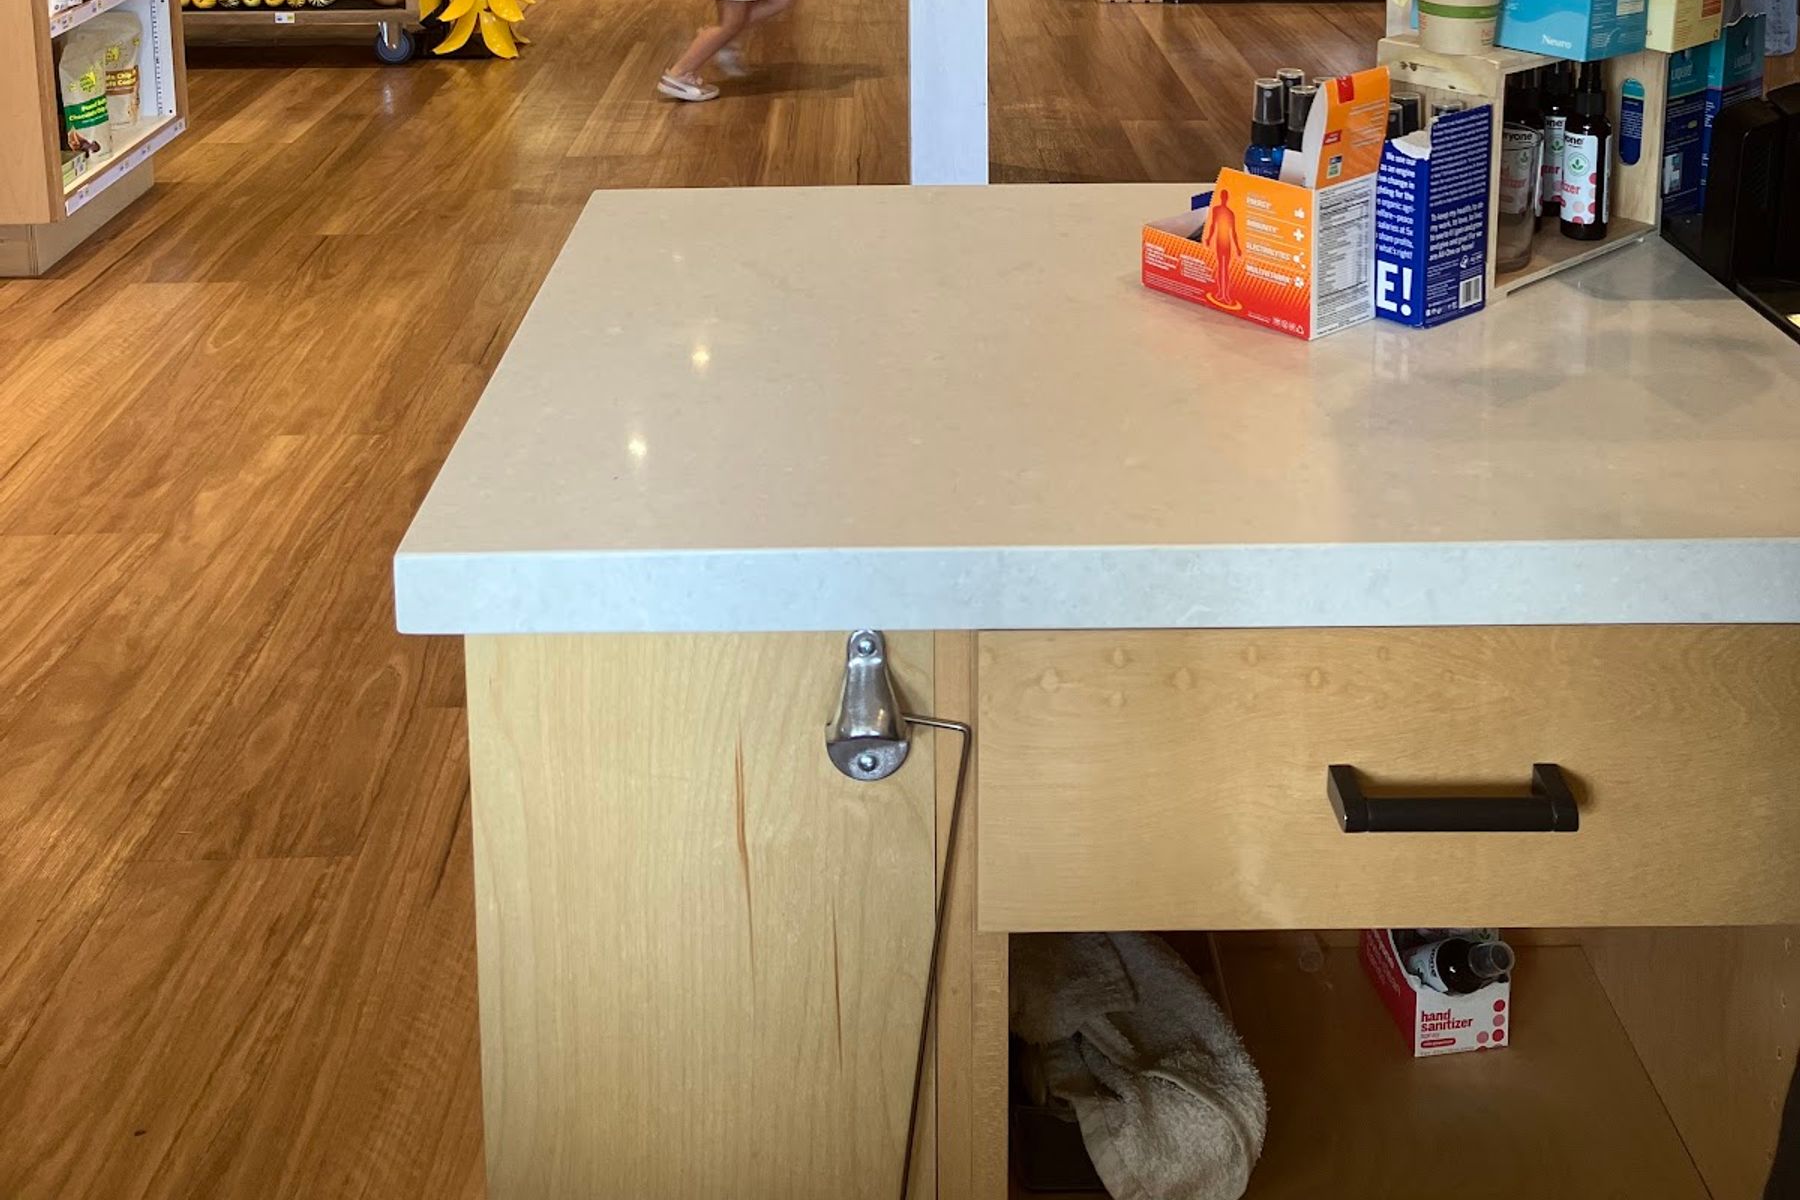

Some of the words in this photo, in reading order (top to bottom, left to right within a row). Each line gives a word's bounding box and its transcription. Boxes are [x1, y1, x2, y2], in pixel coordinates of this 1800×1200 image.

[1542, 34, 1573, 50] Neuro
[1421, 1008, 1451, 1022] hand
[1420, 1018, 1473, 1033] sanitizer
